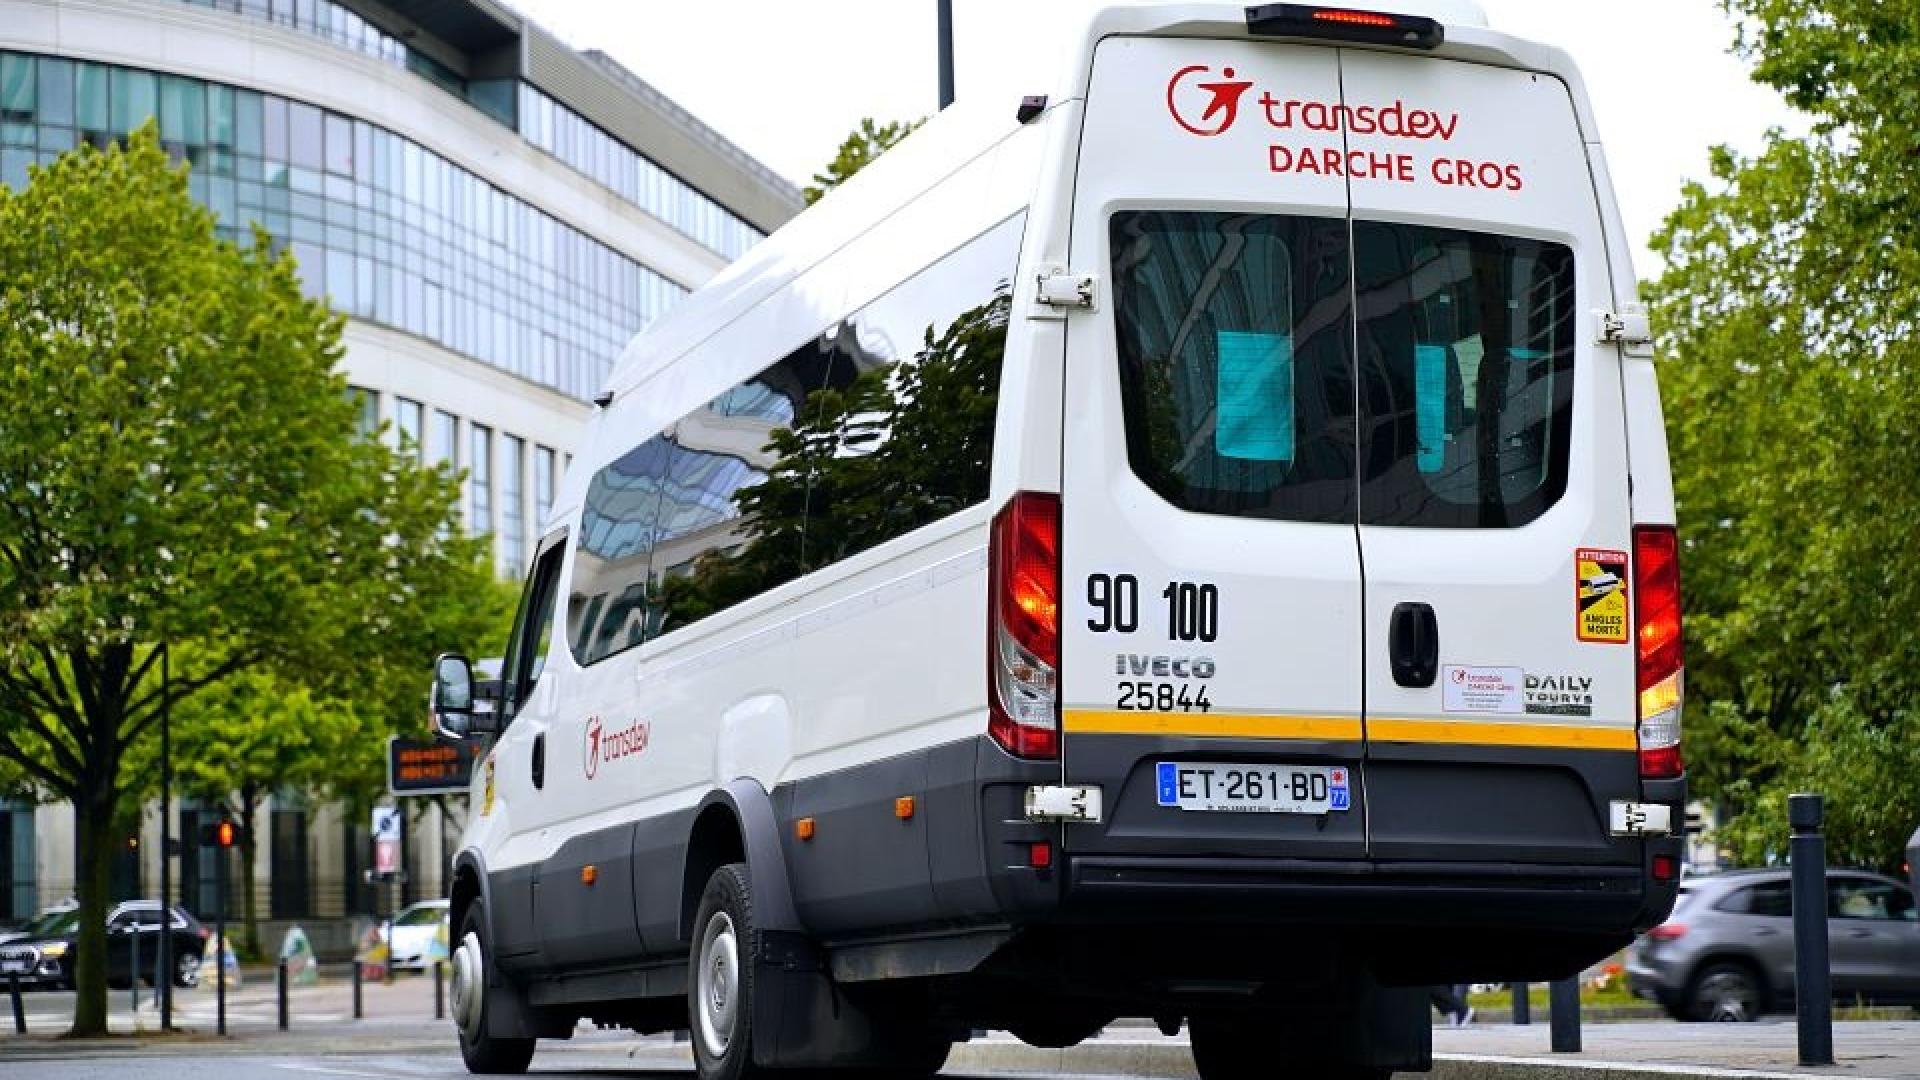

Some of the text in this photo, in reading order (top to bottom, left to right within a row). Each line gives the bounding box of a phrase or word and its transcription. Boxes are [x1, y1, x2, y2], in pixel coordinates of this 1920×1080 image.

[1258, 91, 1458, 140] transdev
[1269, 145, 1522, 190] DARCHE GROS
[1087, 574, 1218, 642] 90 100
[1587, 624, 1621, 635] MORTS
[1115, 653, 1216, 678] IVECO
[1116, 681, 1211, 712] 25844
[1524, 674, 1593, 691] DAILY
[602, 718, 650, 762] transdev
[1179, 769, 1327, 801] ET-261-BD
